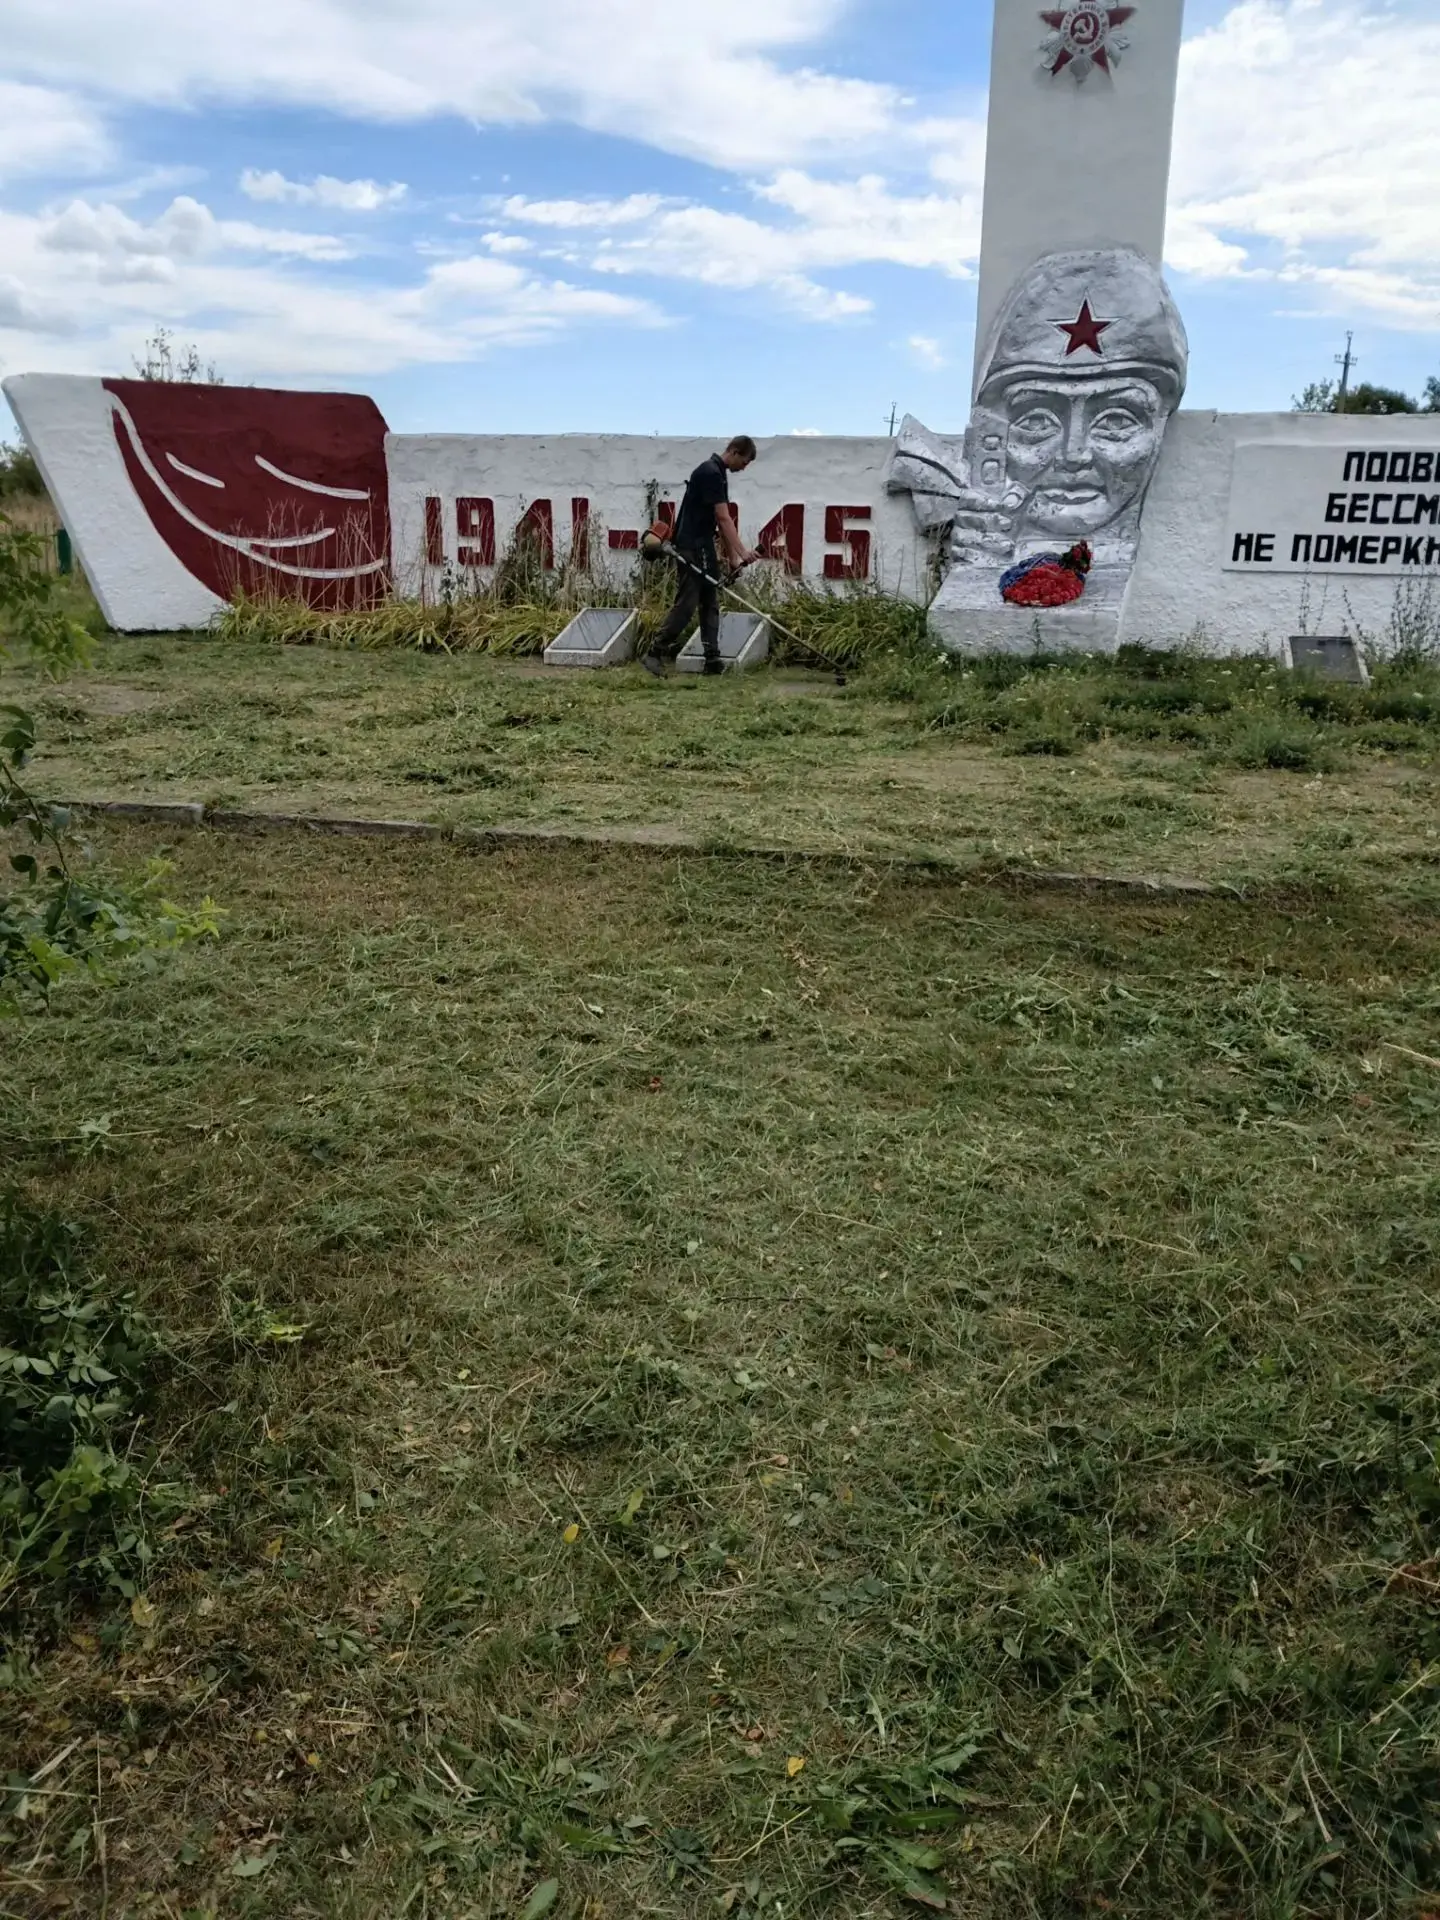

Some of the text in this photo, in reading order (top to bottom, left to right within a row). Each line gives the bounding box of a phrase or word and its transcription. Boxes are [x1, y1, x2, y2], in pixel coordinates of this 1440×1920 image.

[1343, 451, 1440, 482] ПОДВ
[1325, 493, 1440, 524] БЕССМ
[425, 497, 871, 578] 1941-45
[1232, 533, 1275, 562] НЕ
